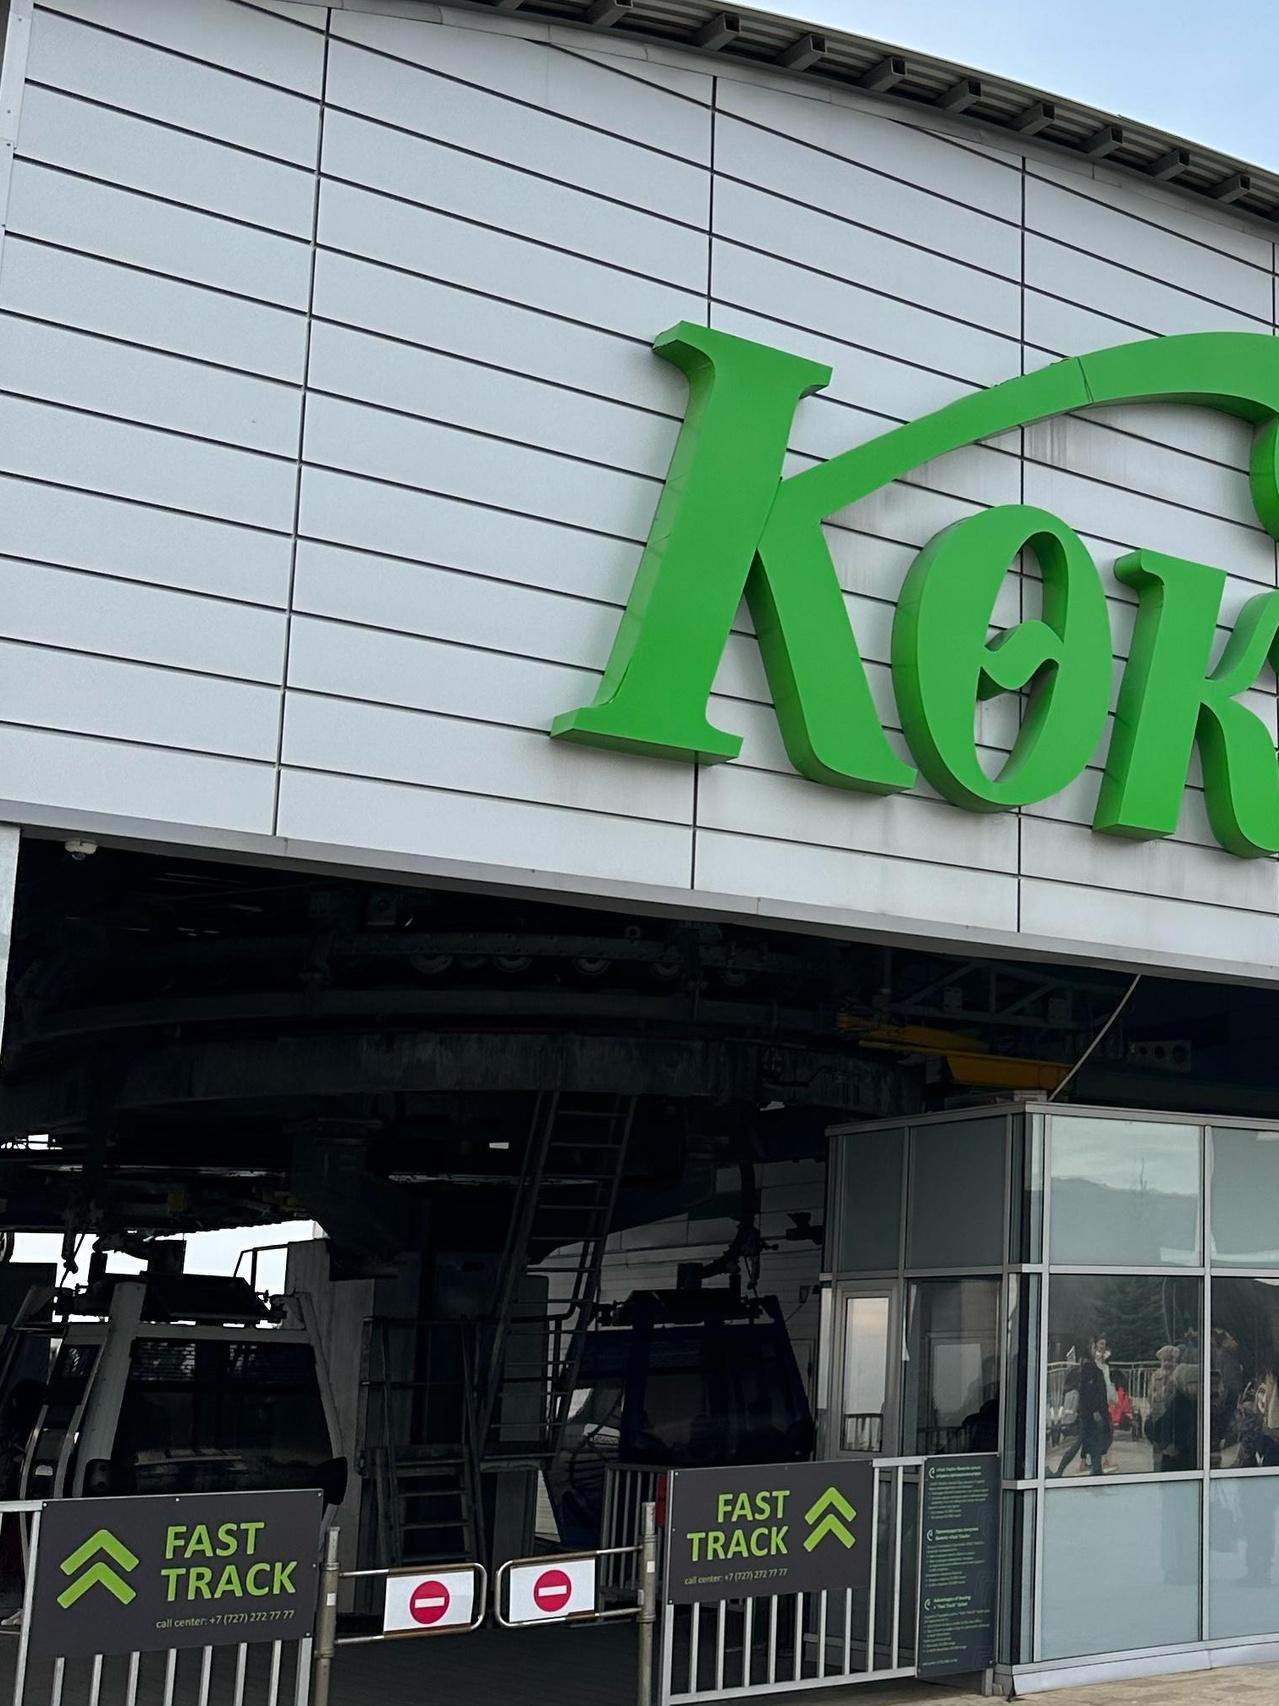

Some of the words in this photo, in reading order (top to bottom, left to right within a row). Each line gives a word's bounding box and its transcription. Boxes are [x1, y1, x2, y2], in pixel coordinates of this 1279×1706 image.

[717, 1490, 790, 1523] FAST
[165, 1522, 265, 1560] FAST
[686, 1526, 789, 1562] TRACK
[160, 1561, 298, 1602] TRACK
[684, 1576, 697, 1585] call
[698, 1575, 722, 1584] center:
[724, 1572, 734, 1581] +7
[734, 1570, 753, 1582] (727)
[754, 1570, 768, 1579] 272
[769, 1568, 778, 1577] 77
[779, 1567, 788, 1576] 77
[156, 1617, 172, 1629] call
[174, 1616, 207, 1628] center:
[209, 1614, 222, 1625] +7
[223, 1612, 248, 1626] (727)
[250, 1611, 267, 1621] 272
[269, 1610, 281, 1621] 77
[283, 1609, 295, 1619] 77
